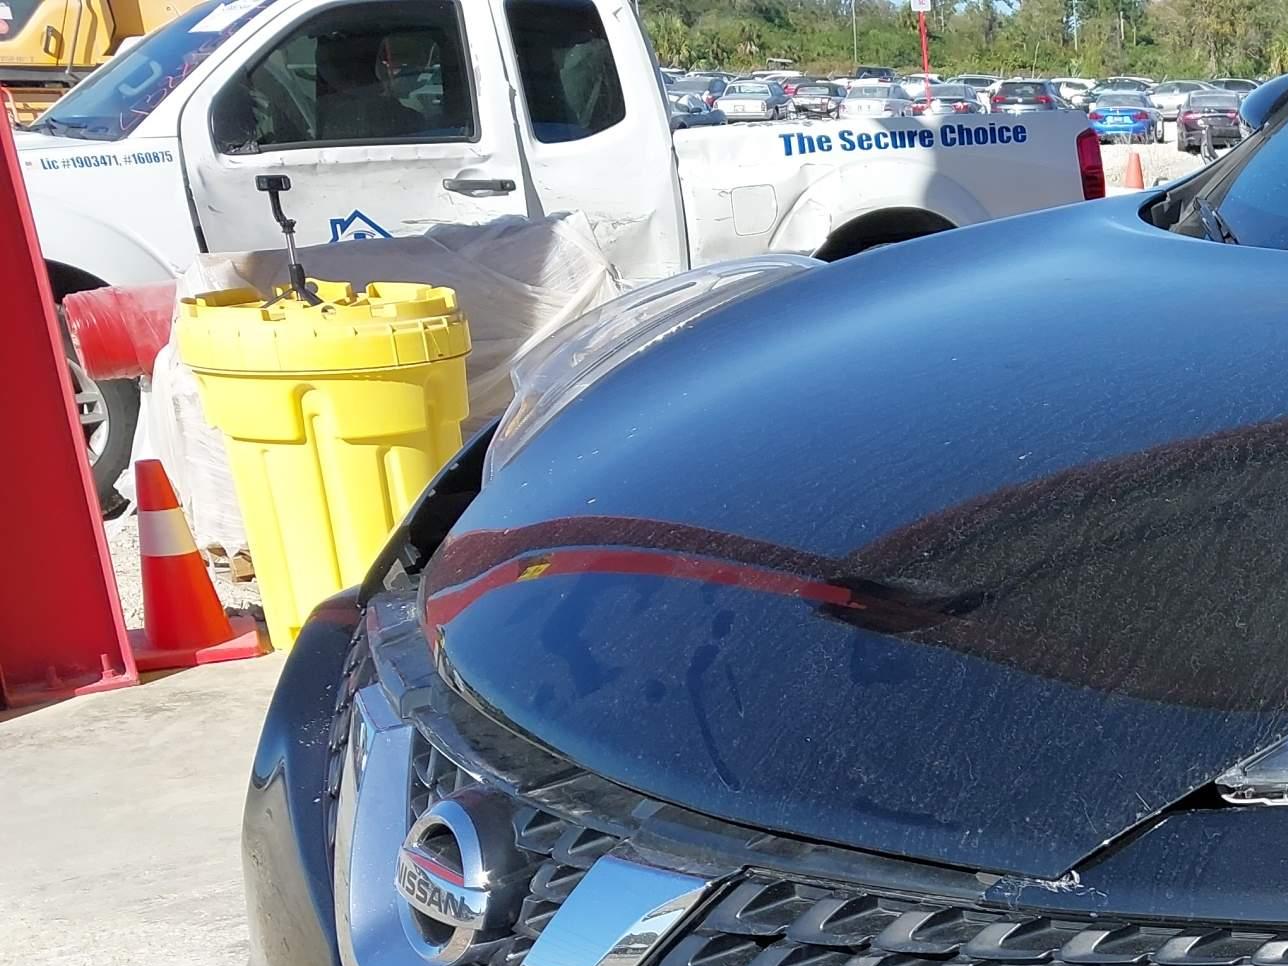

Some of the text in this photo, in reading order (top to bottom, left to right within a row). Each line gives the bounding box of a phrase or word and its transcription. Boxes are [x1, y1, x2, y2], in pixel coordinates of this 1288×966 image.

[778, 123, 1027, 156] The Secure Choice
[40, 157, 60, 170] Lic
[123, 150, 173, 166] #160875
[399, 861, 464, 921] NISSAN
